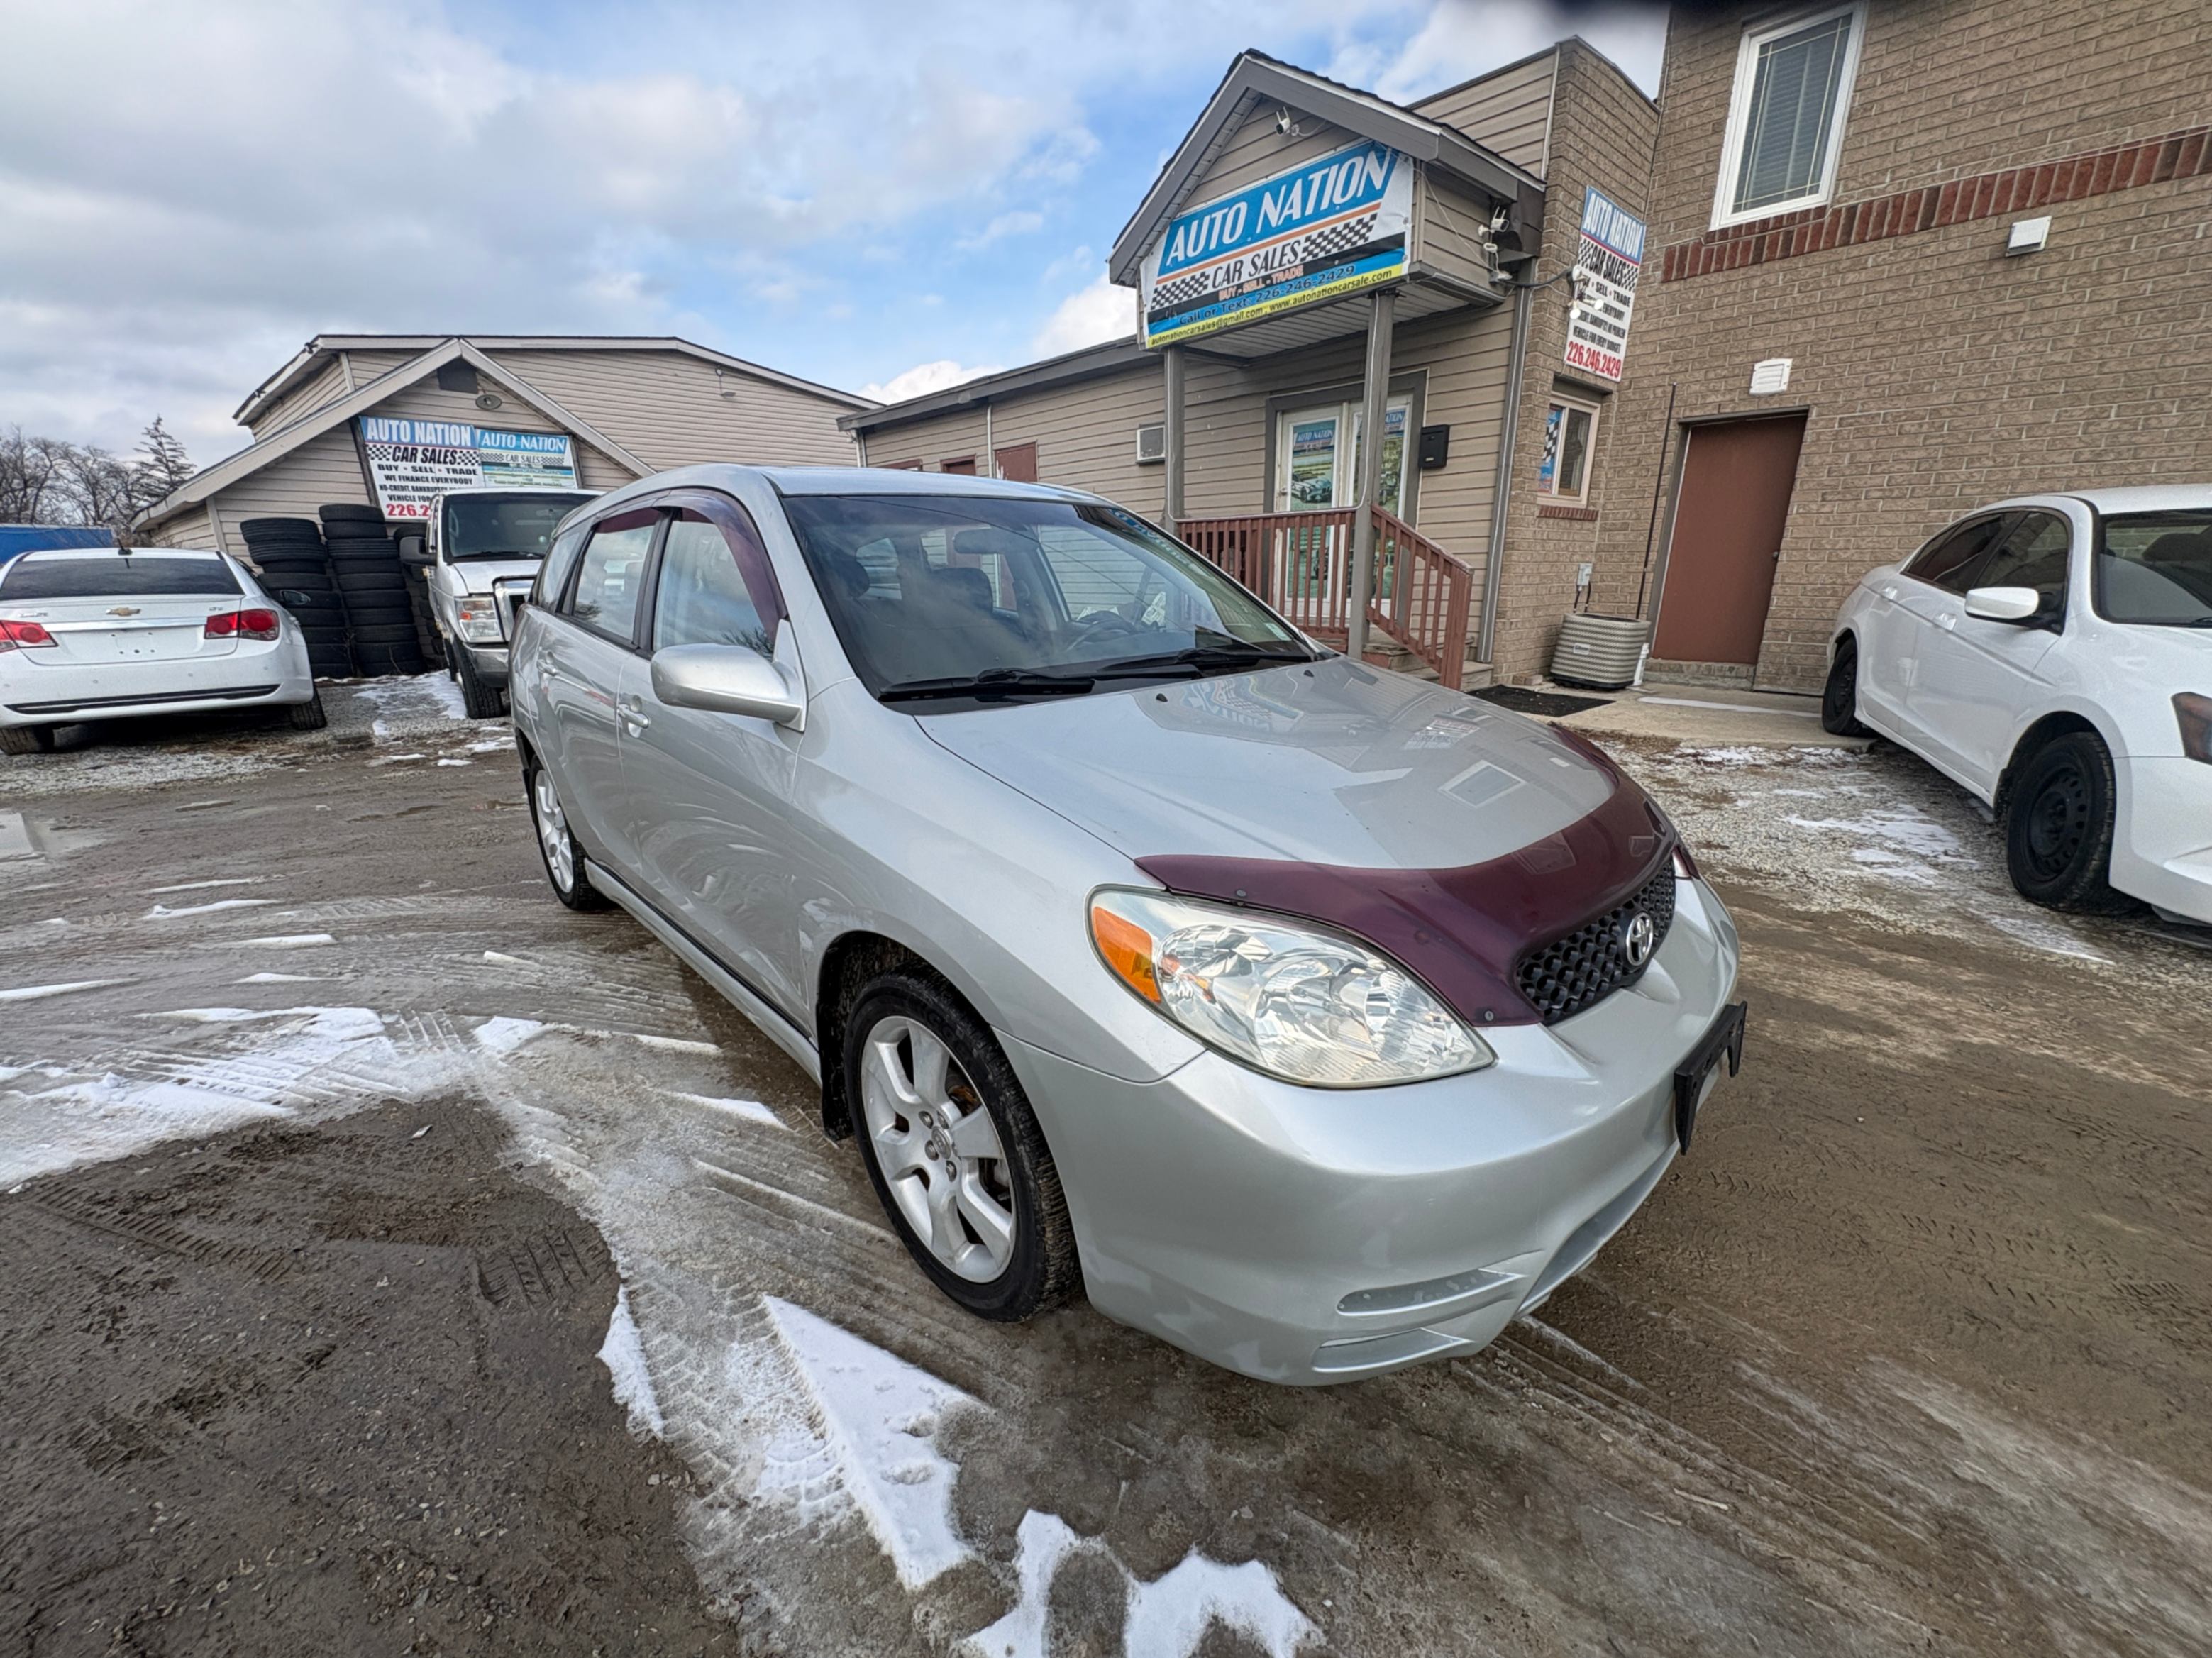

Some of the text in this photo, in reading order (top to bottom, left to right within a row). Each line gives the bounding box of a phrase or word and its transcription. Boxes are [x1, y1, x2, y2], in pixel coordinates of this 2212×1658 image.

[1166, 147, 1393, 266] AUTO NATION
[1583, 193, 1643, 258] AUTO NATION
[1212, 239, 1301, 289] CAR SALES
[1589, 245, 1607, 277] CAR
[1603, 253, 1626, 287] SALES
[1179, 314, 1200, 326] Call
[1204, 308, 1216, 317] or
[1256, 265, 1355, 302] 226-246-2429
[1218, 265, 1304, 301] BUY SELL TRADE
[1269, 270, 1393, 311] www.autonationcarsale.com
[1596, 282, 1608, 297] SELL
[1613, 290, 1631, 307] TRADE
[1566, 341, 1622, 378] 226.246.2429
[367, 418, 471, 446] AUTO NATION
[482, 432, 566, 452] AUTO NATION
[392, 446, 458, 465] CAR SALES
[386, 504, 431, 516] 226.2
